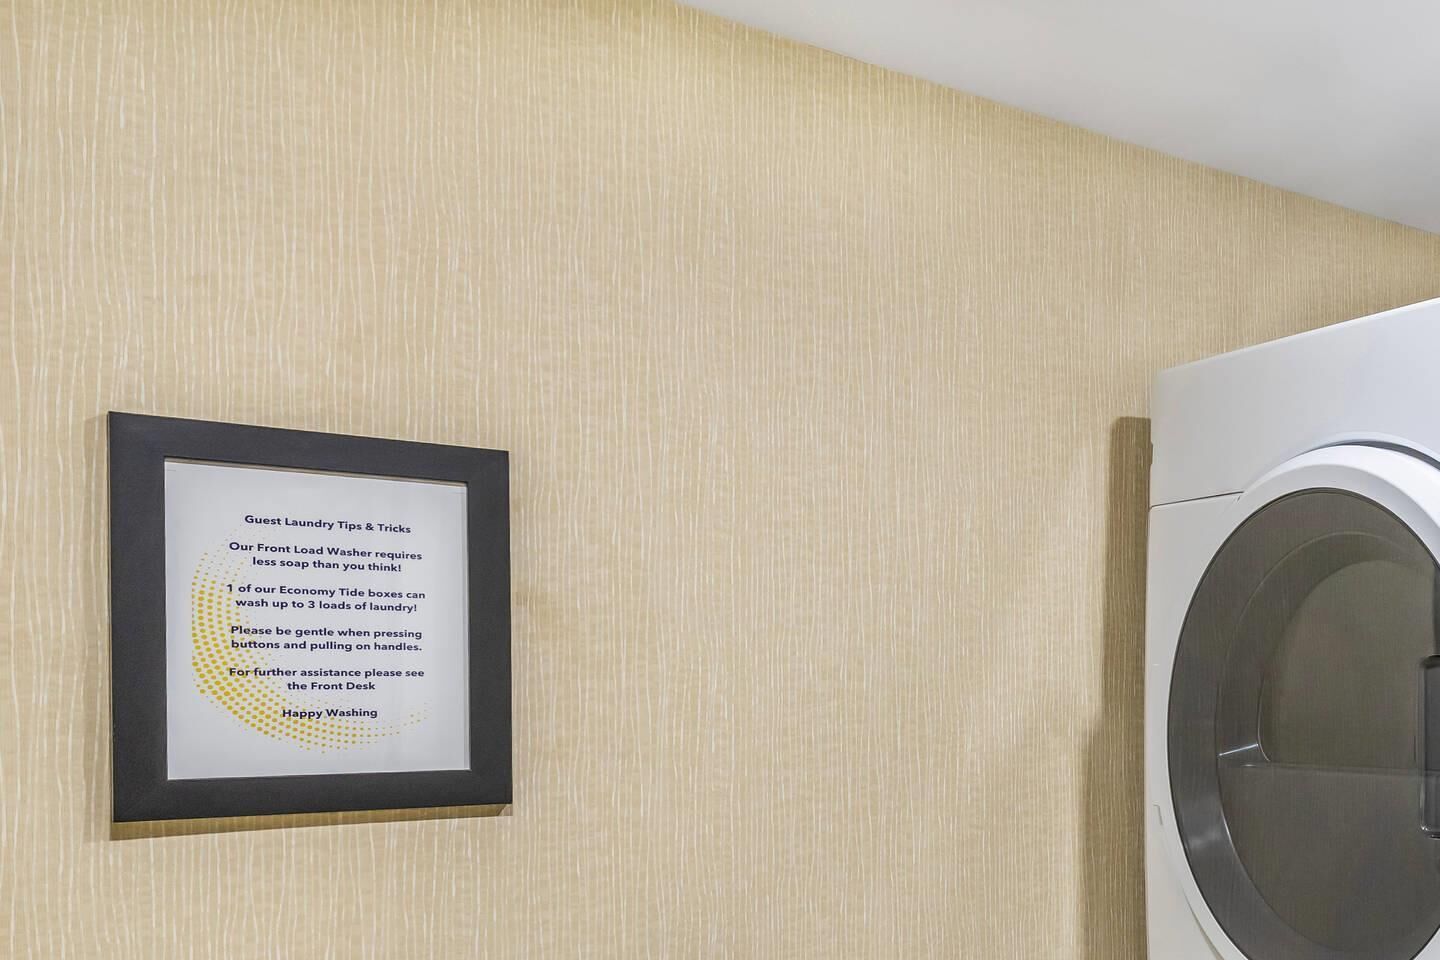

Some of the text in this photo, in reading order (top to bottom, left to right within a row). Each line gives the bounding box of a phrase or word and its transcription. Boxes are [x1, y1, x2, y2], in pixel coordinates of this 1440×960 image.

[244, 514, 412, 534] Guest Laundry Tips & Tricks
[228, 542, 422, 560] Our Front Load Washer requires
[252, 556, 402, 572] less soap than you think!
[226, 584, 426, 600] 1 of our Economy Tide boxes can
[234, 598, 418, 614] wash up to 3 loads of laundry!
[230, 626, 422, 640] Please be gentle when pressing
[230, 640, 422, 652] buttons and pulling on handles.
[228, 666, 424, 678] For further assistance please see
[286, 682, 376, 690] the Front Desk
[282, 708, 378, 720] Happy Washing
